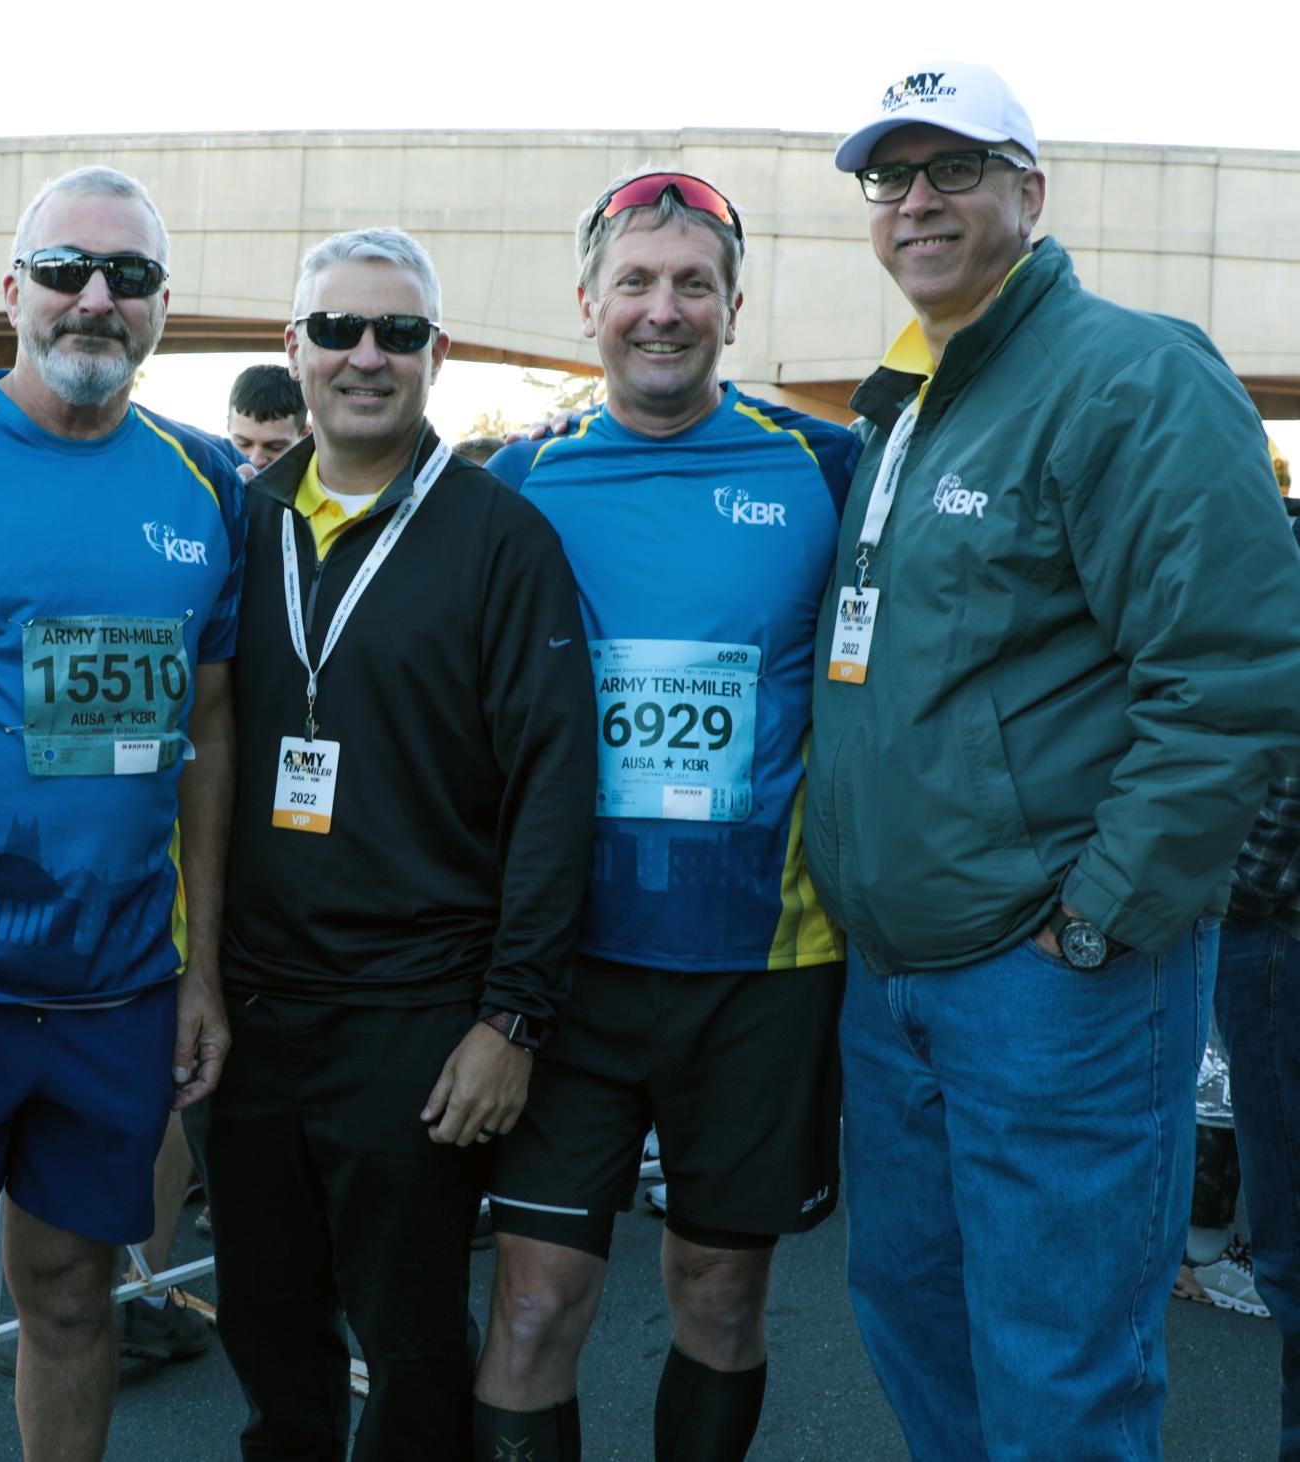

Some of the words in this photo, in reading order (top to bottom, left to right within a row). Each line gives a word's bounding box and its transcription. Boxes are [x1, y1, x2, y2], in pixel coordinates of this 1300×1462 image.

[938, 489, 989, 518] KBR
[732, 502, 787, 527] KBR
[163, 537, 208, 566] KBR
[42, 628, 96, 645] ARMY
[101, 628, 174, 646] TEN-MILER
[718, 651, 748, 664] 6929
[841, 642, 860, 655] 2022
[32, 654, 187, 704] 15510
[600, 676, 647, 694] ARMY
[651, 676, 742, 698] TEN-MILER
[71, 711, 105, 726] AUSA
[131, 711, 157, 725] KBR
[602, 702, 733, 751] 6929
[621, 757, 655, 769] AUSA
[682, 758, 709, 772] KBR
[289, 791, 317, 806] 2022
[291, 813, 311, 826] VIP
